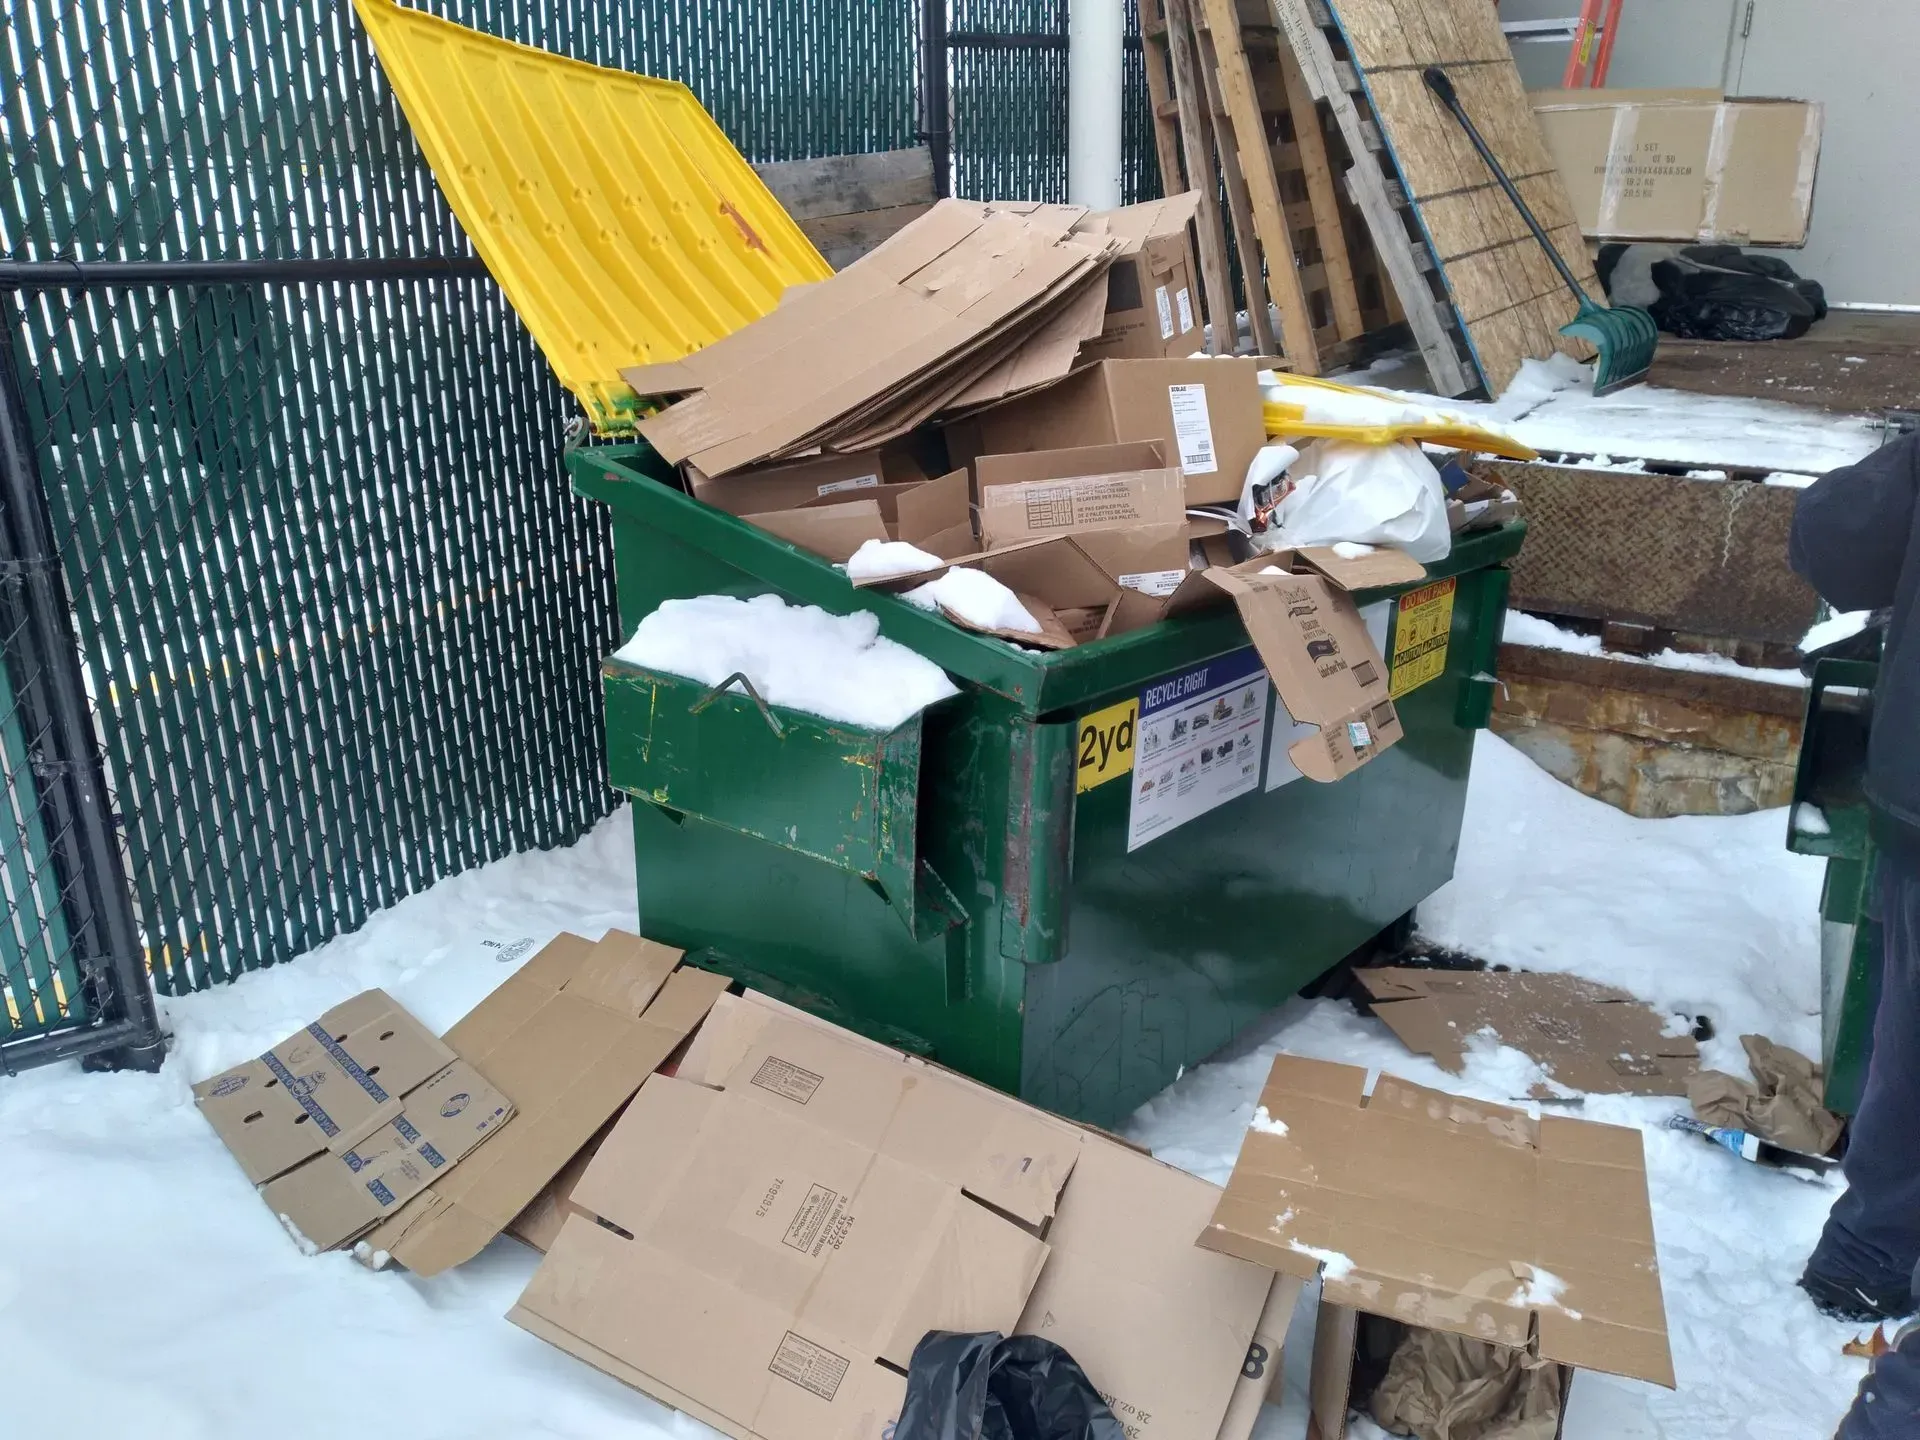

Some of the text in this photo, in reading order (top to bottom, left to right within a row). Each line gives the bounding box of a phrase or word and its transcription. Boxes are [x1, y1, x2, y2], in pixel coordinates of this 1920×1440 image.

[1644, 142, 1659, 152] SET
[1406, 580, 1452, 609] DO NOT PARK
[1399, 646, 1421, 665] CAUTION
[1145, 667, 1209, 710] RECYCLE RIGHT
[1078, 707, 1136, 773] 2yd
[792, 1203, 814, 1239] WestRock
[827, 1214, 849, 1246] 337722
[834, 1215, 856, 1251] KF-9120
[1241, 1342, 1269, 1381] 8
[1118, 1402, 1137, 1416] oz.
[1136, 1410, 1152, 1425] 28
[1124, 1425, 1140, 1439] 28
